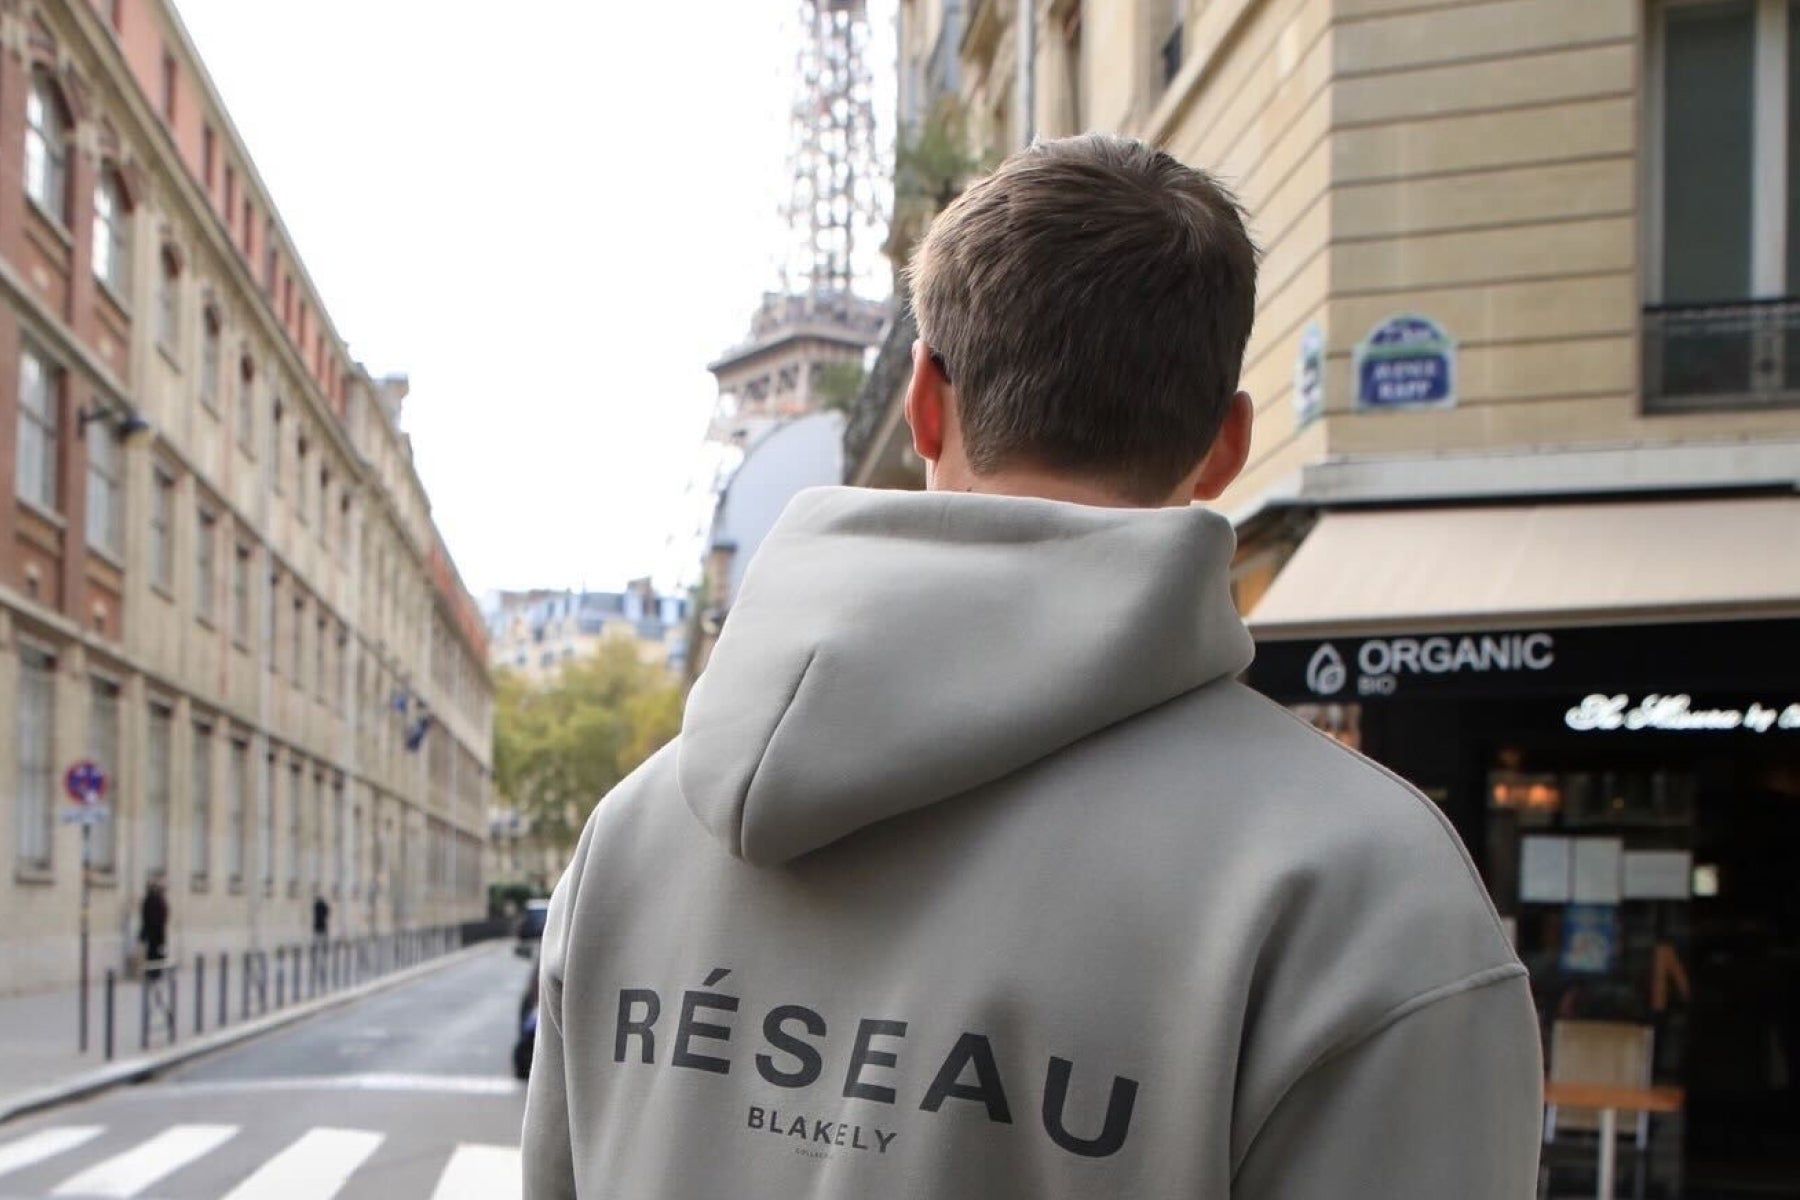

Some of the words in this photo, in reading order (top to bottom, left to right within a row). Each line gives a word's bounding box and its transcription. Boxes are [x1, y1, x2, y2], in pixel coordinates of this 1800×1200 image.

[1358, 633, 1555, 674] ORGANIC
[1358, 674, 1397, 695] BIO
[613, 968, 1139, 1158] RÉSEAU
[747, 1106, 897, 1153] BLAKELY
